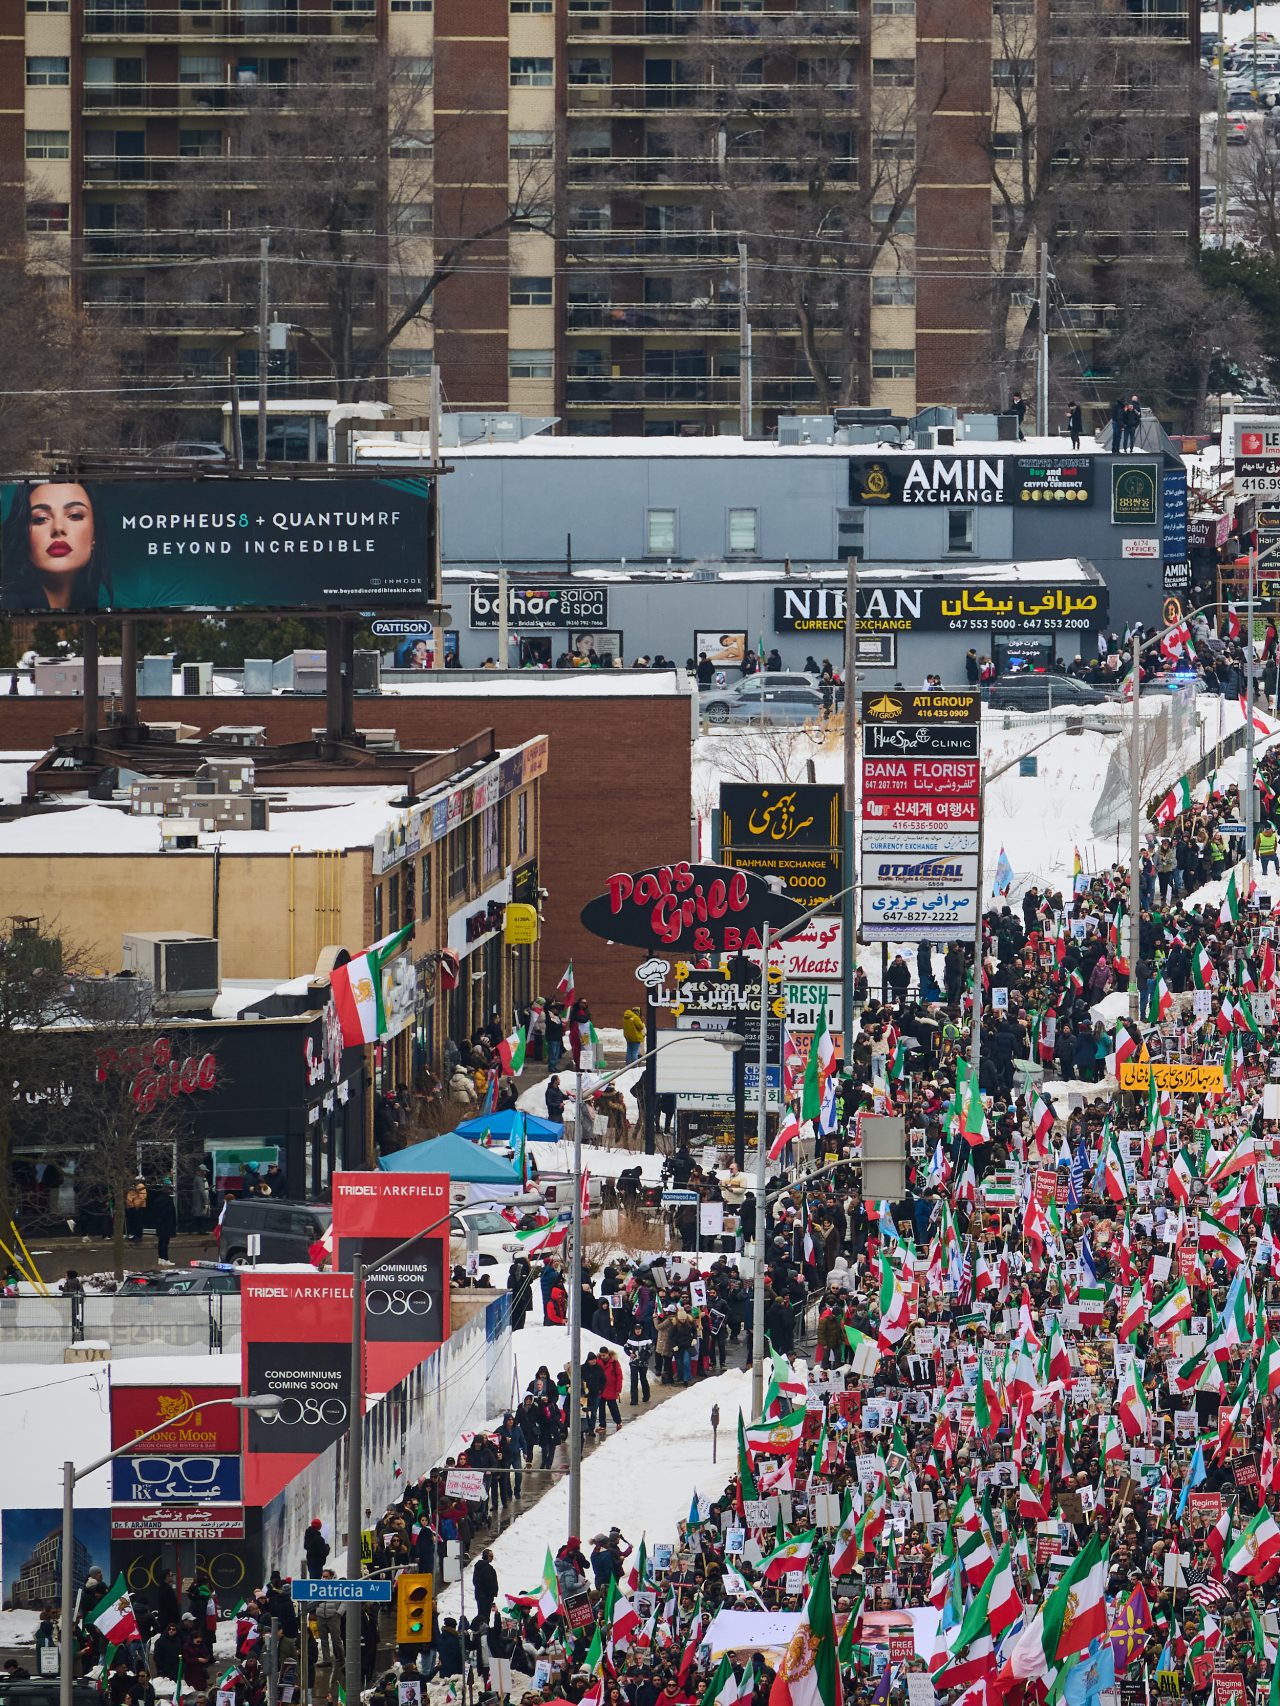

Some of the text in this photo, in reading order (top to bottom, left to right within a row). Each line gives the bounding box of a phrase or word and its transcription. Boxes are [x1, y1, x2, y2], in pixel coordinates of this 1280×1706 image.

[904, 459, 1004, 490] AMIN
[1046, 468, 1061, 476] and
[903, 490, 1004, 502] EXCHANGE
[273, 511, 401, 530] QUANTUMRF
[1187, 524, 1210, 534] eauty
[1188, 534, 1206, 544] alon
[148, 539, 376, 555] BEYOND INCREDIBLE
[1164, 564, 1188, 577] AMIN
[560, 589, 603, 602] salon
[783, 589, 923, 619] NIKAN
[941, 589, 1097, 616] صرافی نیکان
[560, 602, 603, 617] & spa
[376, 622, 427, 633] PATTISON
[855, 620, 912, 630] EXCHANGE
[949, 619, 1090, 629] 647 553 5000 647 553 2000
[913, 697, 973, 707] ATI GROUP
[931, 740, 971, 748] CLINIC
[865, 763, 976, 777] BANA FLORIST
[914, 779, 976, 792] گلفروشی بانا
[893, 801, 976, 817] 신세계 여행사
[892, 822, 948, 830] 416-536-5000
[736, 859, 827, 868] BAHMANI EXCHANGE
[605, 860, 695, 915] Pars
[789, 876, 827, 887] 0000
[872, 890, 970, 911] صرافی عزیزی
[651, 871, 750, 944] Grill
[883, 912, 959, 921] 647-827-2222
[694, 926, 783, 951] & BAR
[789, 956, 840, 973] Meats
[783, 985, 828, 1005] FRESH
[338, 1185, 443, 1196] TRIDEL ARKFIELD
[399, 1274, 424, 1282] SOON
[247, 1287, 354, 1298] TRIDEL ARKFIELD
[365, 1289, 432, 1315] 080
[264, 1370, 342, 1379] CONDOMINIUMS
[268, 1381, 338, 1390] COMING SOON
[179, 1429, 217, 1441] MOON
[155, 1482, 221, 1500] عینک
[142, 1508, 213, 1521] چشم پزشکی
[133, 1528, 224, 1538] OPTOMETRIST
[309, 1583, 363, 1598] Patricia
[891, 1640, 913, 1649] FREE
[891, 1648, 913, 1657] IRAN
[1216, 1679, 1242, 1689] Regime
